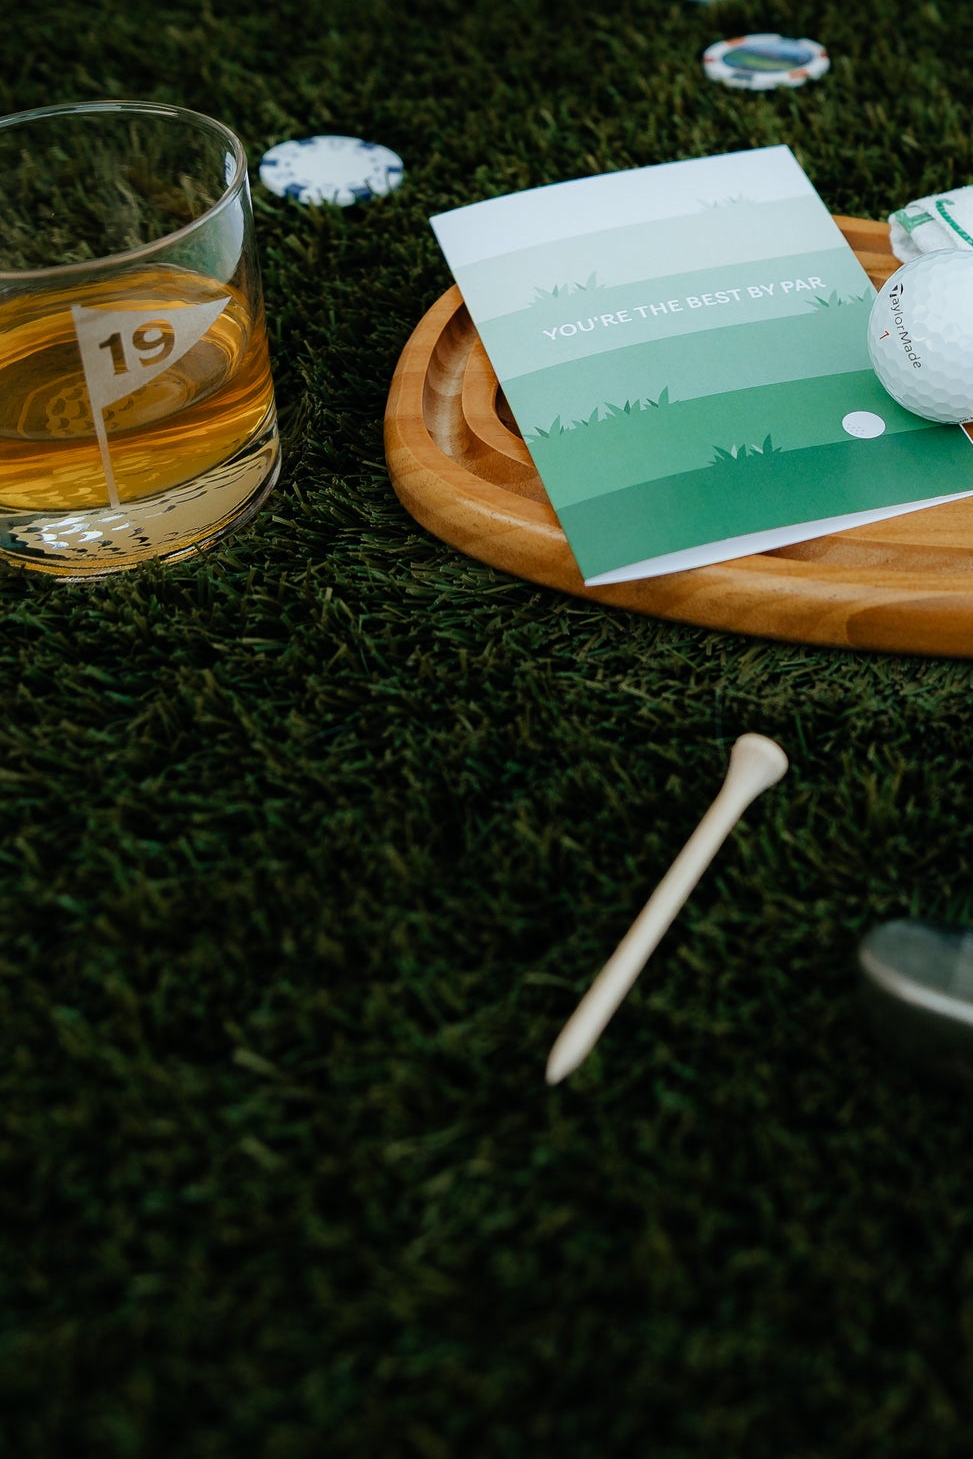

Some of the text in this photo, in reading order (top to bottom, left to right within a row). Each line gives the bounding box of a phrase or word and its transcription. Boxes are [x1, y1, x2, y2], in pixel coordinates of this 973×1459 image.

[542, 276, 827, 341] YOU'RE THE BEST BY PAR
[889, 283, 922, 369] TaylorMade
[98, 318, 176, 376] 19
